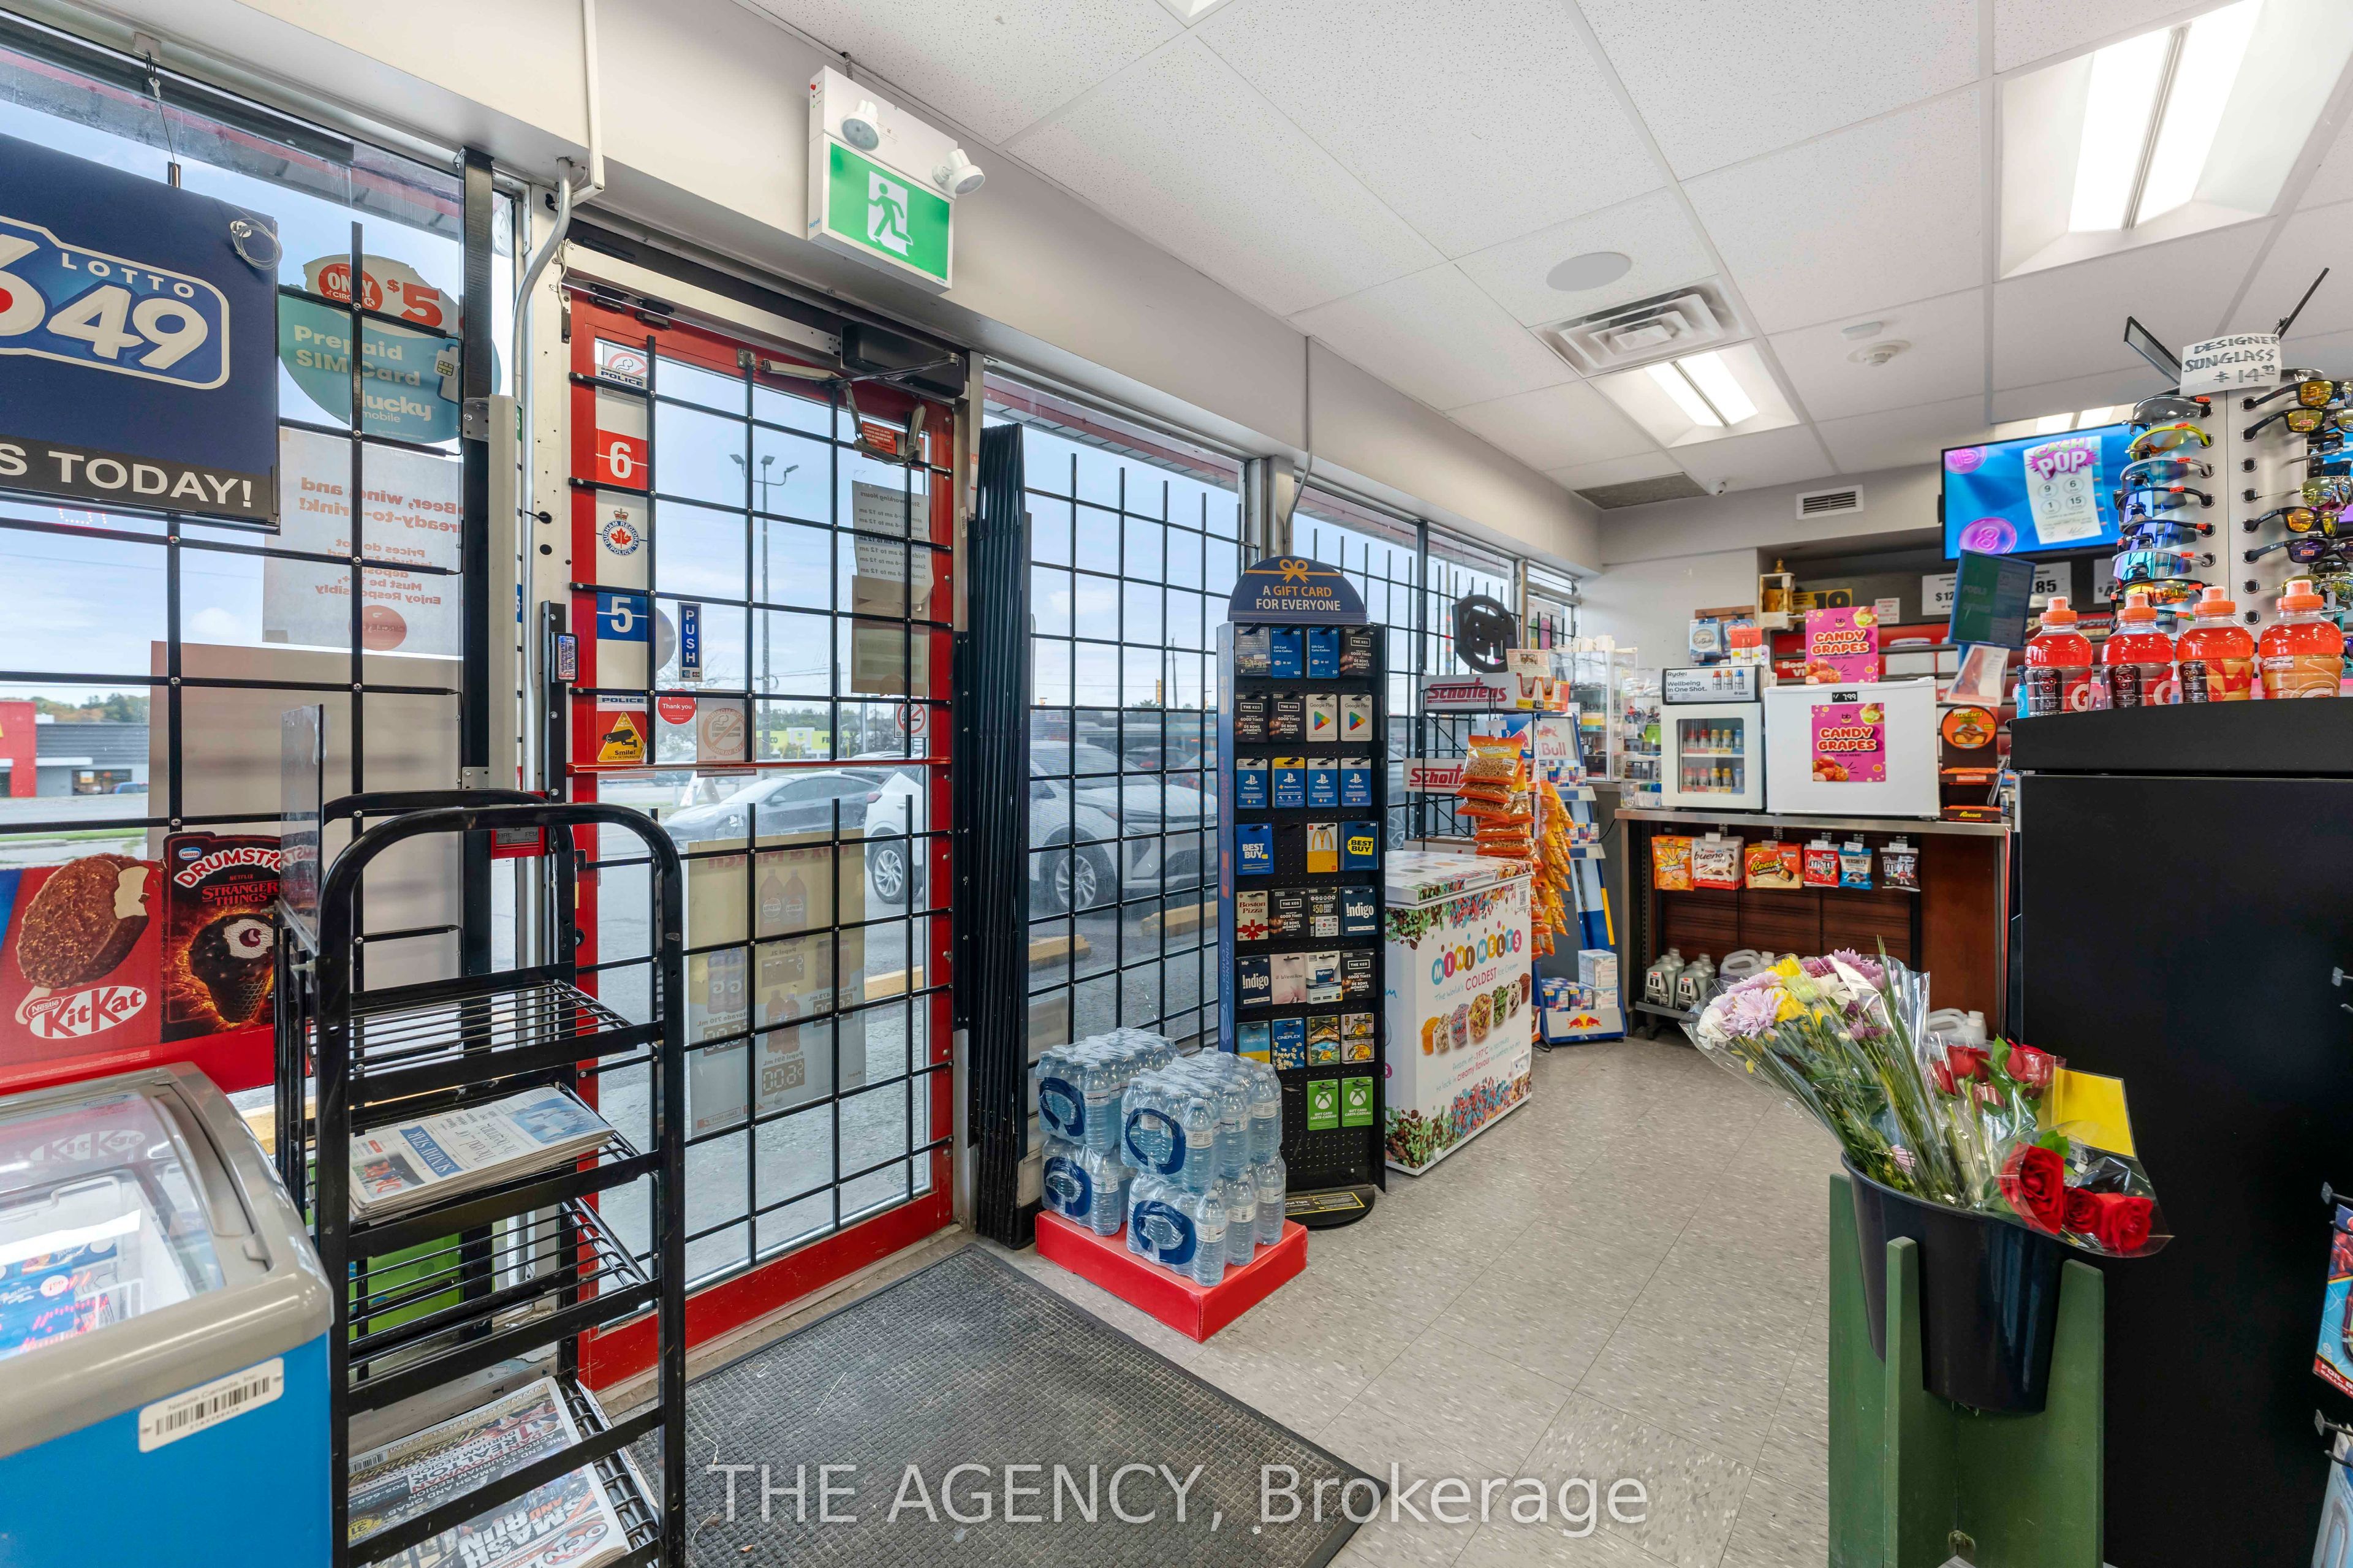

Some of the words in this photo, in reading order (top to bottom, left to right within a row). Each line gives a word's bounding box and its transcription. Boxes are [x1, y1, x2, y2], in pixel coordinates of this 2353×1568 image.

[62, 252, 194, 298] LOTTO
[328, 273, 373, 297] ONY
[2194, 336, 2279, 355] DESIGNER
[297, 349, 347, 373] SIM
[2183, 349, 2275, 373] SUNGLASS
[601, 371, 643, 387] POLICE
[610, 441, 632, 479] 6
[2037, 450, 2088, 480] POP
[48, 451, 252, 507] TODAY!
[603, 521, 620, 545] DURHAM
[620, 521, 639, 548] REGIONAL
[1976, 527, 2001, 550] 8
[610, 547, 634, 556] POLICE
[1263, 586, 1271, 596] A
[1273, 586, 1298, 596] GIFT
[1302, 586, 1332, 597] CARD
[610, 596, 633, 633] 5
[1256, 599, 1279, 610] FOR
[1282, 600, 1341, 612] EVERYONE
[686, 610, 696, 664] PUSH
[1814, 630, 1866, 643] CANDY
[1811, 642, 1870, 655] GRAPES
[1821, 727, 1873, 738] CANDY
[1541, 742, 1566, 756] Bull
[1817, 740, 1877, 751] GRAPES
[1243, 843, 1264, 852] BEST
[1245, 850, 1262, 859] BUY
[1694, 852, 1723, 861] bueno
[202, 882, 279, 902] STRANGER
[215, 893, 268, 906] THINGS
[1313, 903, 1324, 914] $50
[1433, 947, 1474, 983] MINI
[1478, 931, 1520, 961] MELTS
[1466, 967, 1497, 991] COLDEST
[406, 1131, 428, 1151] STAR
[423, 1145, 455, 1173] SUNDAY
[2321, 1363, 2344, 1384] FOIL
[508, 1432, 543, 1450] DAN
[509, 1433, 556, 1456] ACROSS
[521, 1445, 544, 1457] END
[545, 1435, 567, 1447] THE
[413, 1434, 517, 1485] REALTOR
[457, 1455, 507, 1479] DURHAM
[502, 1457, 517, 1466] TO
[412, 1450, 504, 1493] PLOWMAN
[408, 1474, 456, 1499] REGION
[427, 1485, 453, 1499] AND
